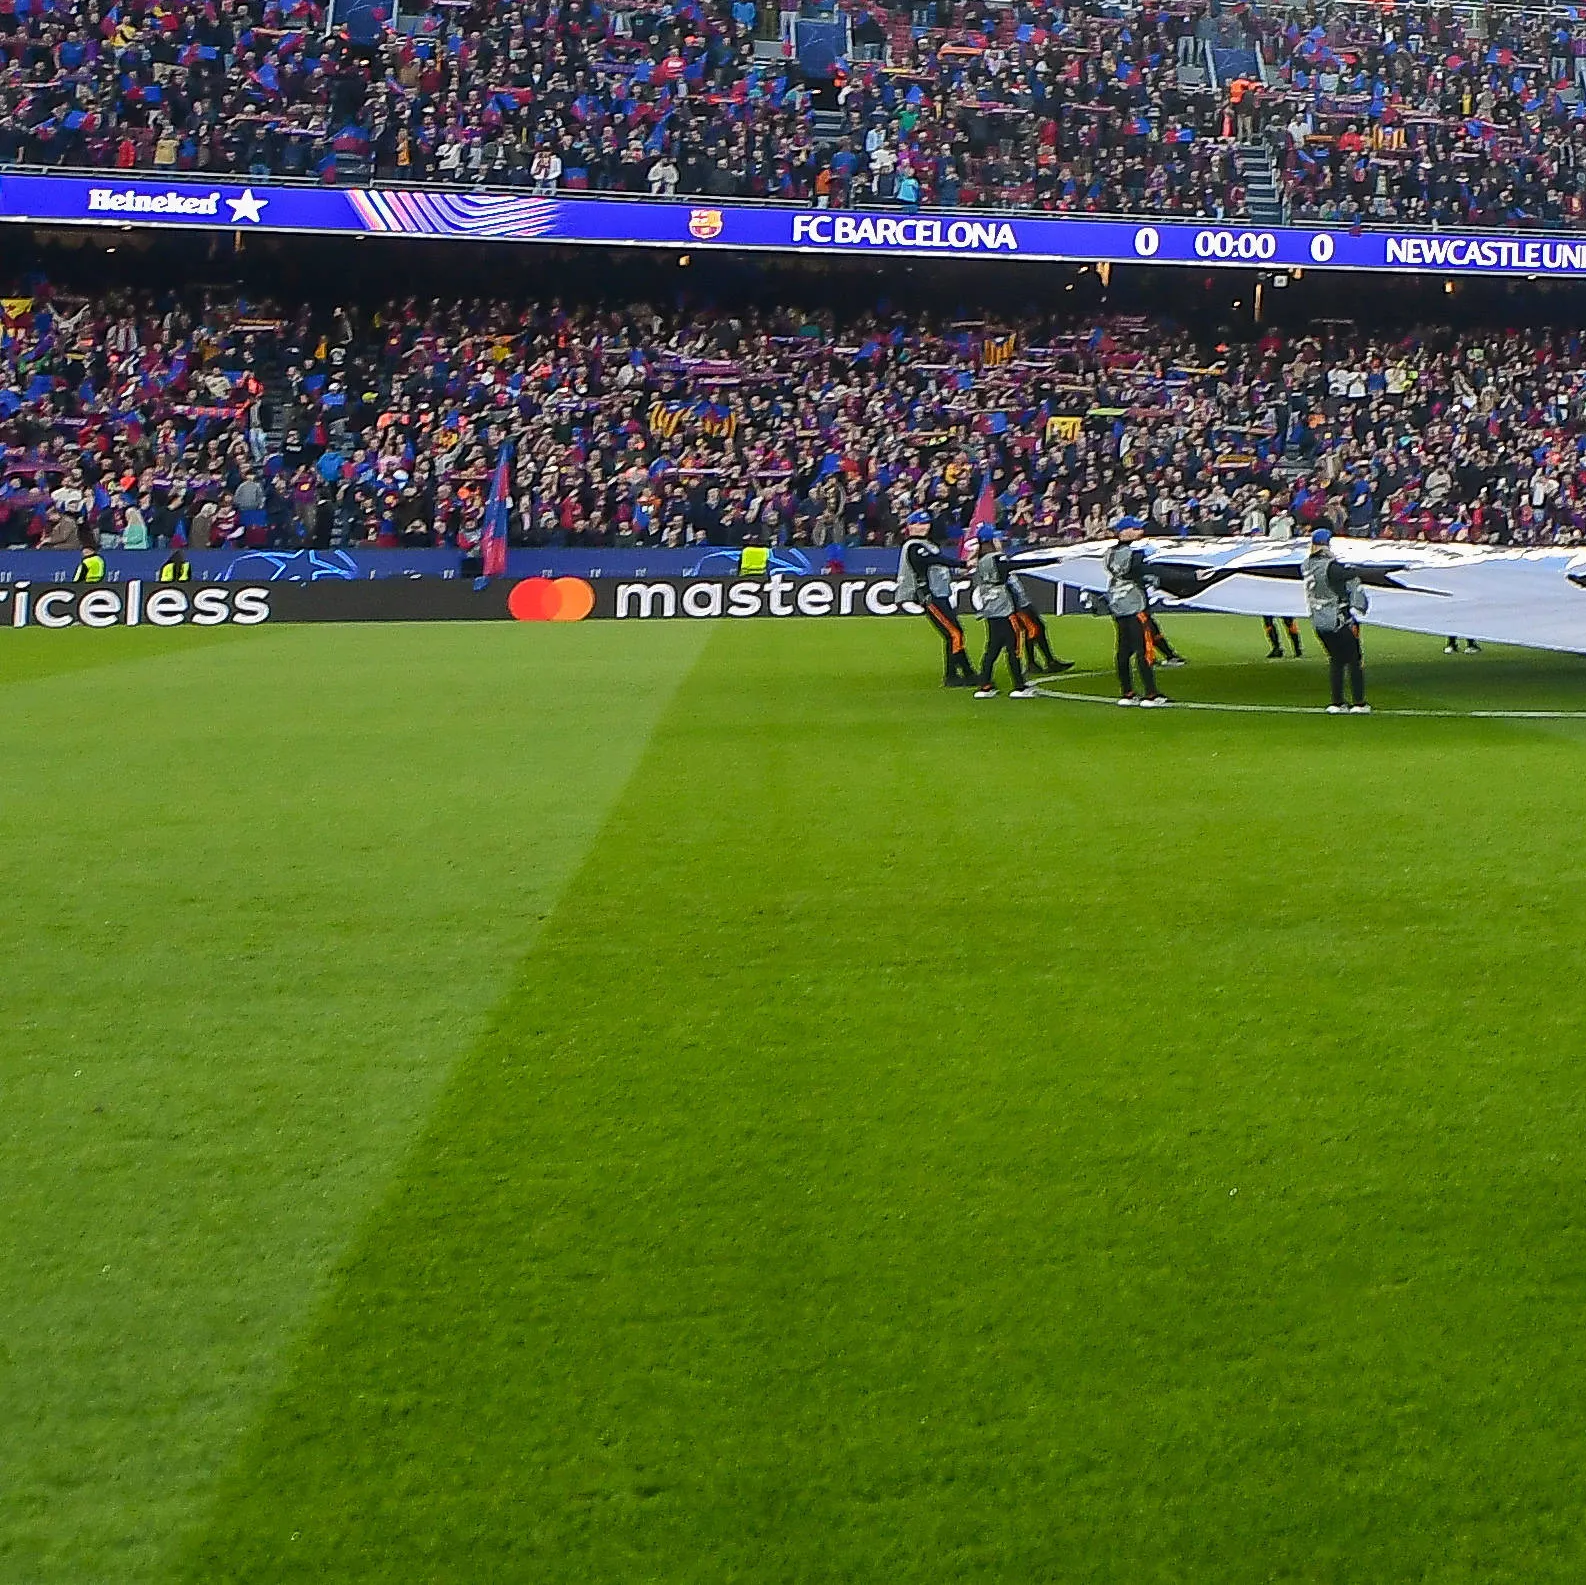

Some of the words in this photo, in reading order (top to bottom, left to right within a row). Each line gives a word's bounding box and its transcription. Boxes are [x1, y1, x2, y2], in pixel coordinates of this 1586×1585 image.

[88, 188, 221, 215] Heineken
[792, 215, 833, 243] FC
[834, 216, 1018, 250] BARCELONA
[1134, 227, 1159, 256] 0
[1194, 230, 1276, 259] 00:00
[1310, 233, 1334, 262] 0
[1386, 237, 1541, 268] NEWCASTLE
[0, 579, 270, 626] iceless
[615, 574, 985, 617] mastercr
